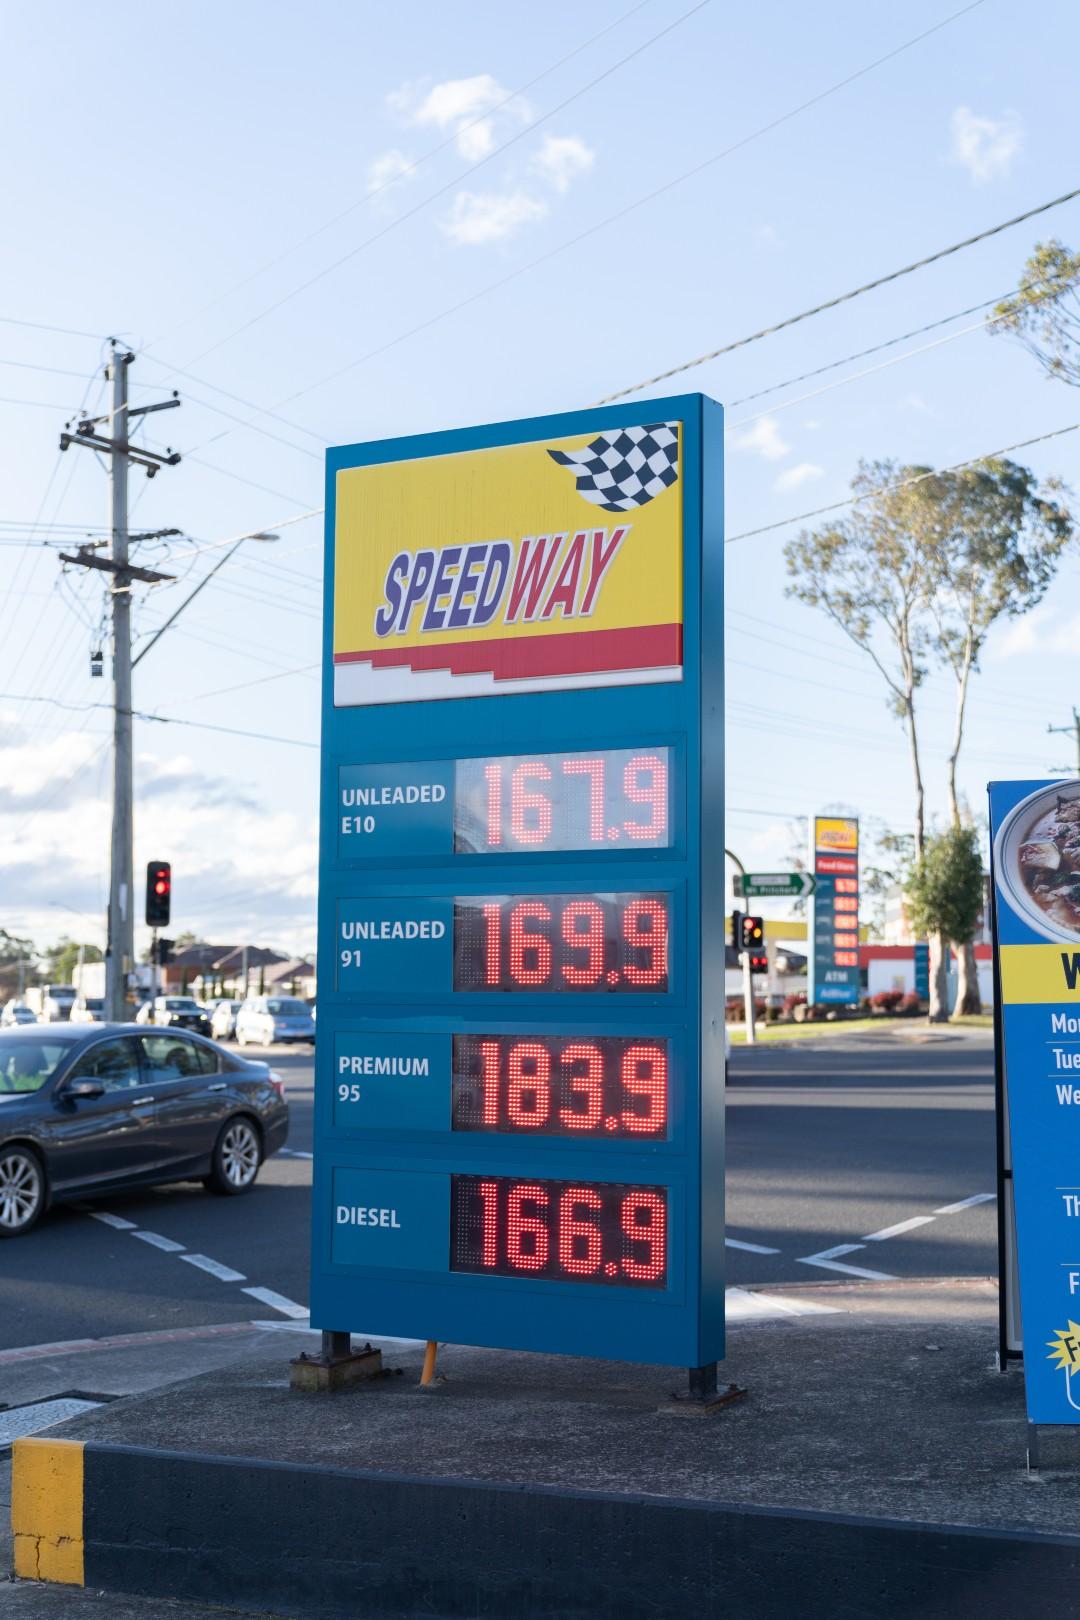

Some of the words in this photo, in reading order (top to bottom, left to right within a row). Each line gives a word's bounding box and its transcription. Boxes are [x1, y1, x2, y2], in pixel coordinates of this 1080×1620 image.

[374, 525, 632, 638] SPEEDWAY
[342, 784, 446, 807] UNLEADED
[484, 755, 666, 845] 167.9
[341, 815, 376, 834] E10
[341, 920, 446, 940] UNLEADED
[483, 899, 667, 985] 169.9
[341, 949, 362, 968] 91
[825, 971, 848, 982] ATM
[338, 1056, 429, 1077] PREMIUM
[338, 1084, 361, 1102] 95
[482, 1042, 667, 1132] 183.9
[336, 1206, 401, 1228] DIESEL
[481, 1182, 667, 1280] 166.9
